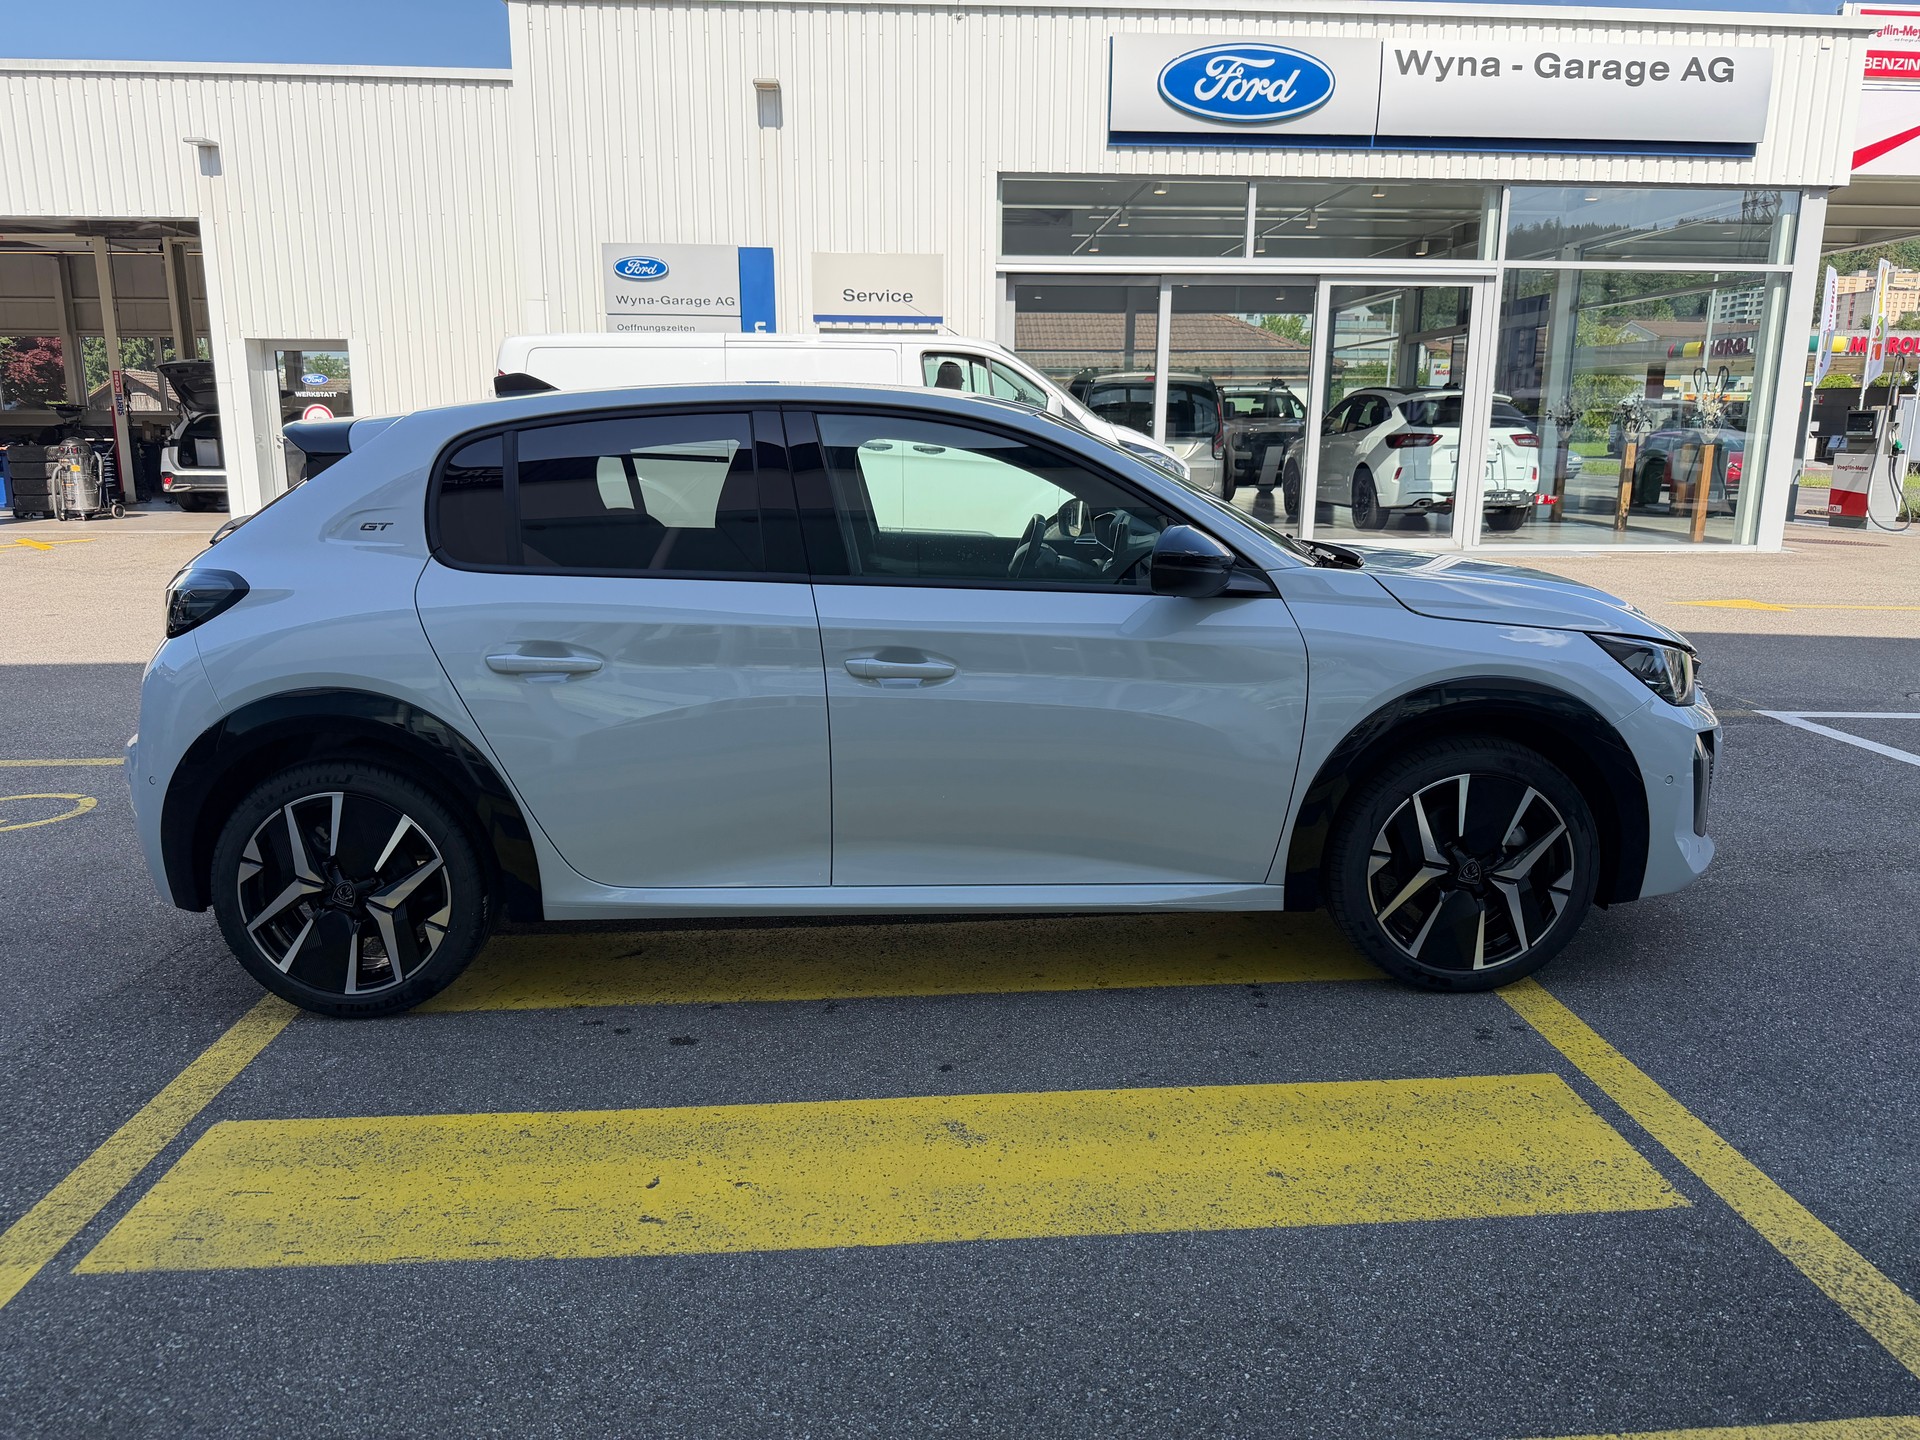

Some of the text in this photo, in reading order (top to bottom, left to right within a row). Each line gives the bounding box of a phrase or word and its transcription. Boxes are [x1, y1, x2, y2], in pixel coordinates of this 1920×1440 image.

[1395, 49, 1501, 82] Wyna
[1533, 52, 1670, 87] Garage
[1680, 56, 1735, 83] AG
[1864, 57, 1920, 70] BENZIN
[1194, 55, 1301, 103] Ford
[624, 260, 657, 275] Ford
[615, 295, 735, 307] Wyna-Garage AG
[843, 288, 914, 303] Service
[617, 323, 696, 333] Oeffnungszeiten
[1849, 336, 1920, 355] MROL
[360, 522, 394, 531] GT
